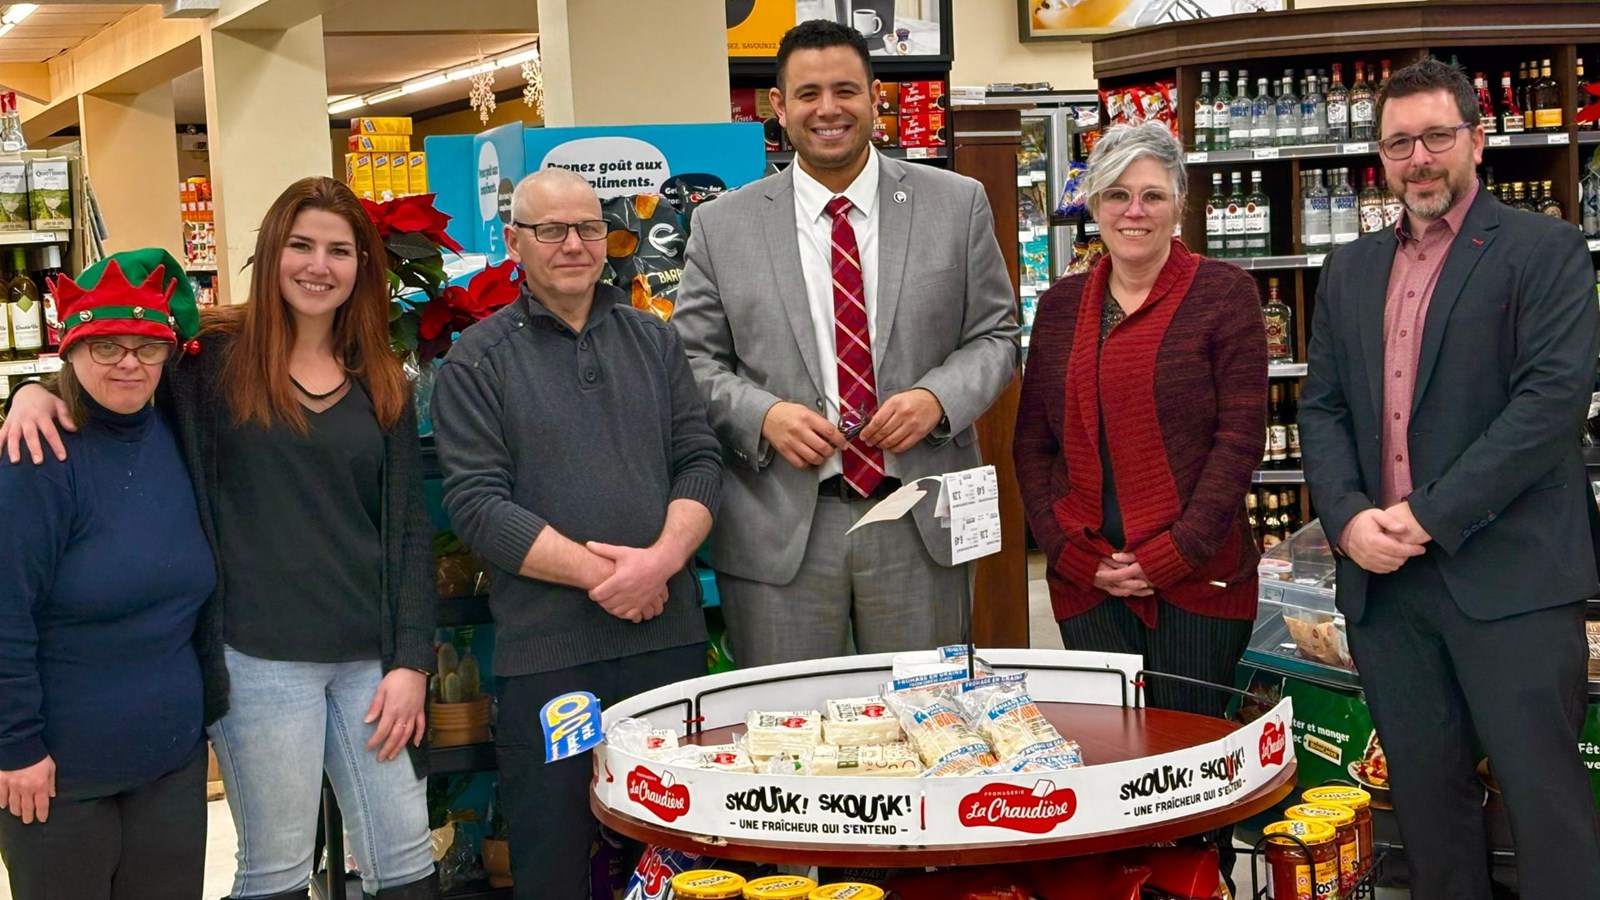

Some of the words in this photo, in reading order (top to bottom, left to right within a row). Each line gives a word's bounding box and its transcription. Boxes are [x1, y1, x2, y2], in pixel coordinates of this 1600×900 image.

[599, 160, 632, 174] goût
[635, 161, 662, 170] aux
[588, 177, 654, 188] pliments.
[1293, 718, 1305, 729] ter
[1307, 724, 1316, 733] et
[1317, 727, 1350, 743] manger
[1577, 742, 1600, 754] Fêt
[639, 780, 684, 809] Chaudière
[984, 789, 1025, 797] FROMAGERIE
[966, 801, 986, 819] La
[987, 798, 1068, 822] Chaudière
[1134, 804, 1152, 817] UNE
[1155, 793, 1202, 813] FRAÎCHEUR
[1203, 789, 1216, 801] QUI
[739, 819, 759, 830] UNE
[762, 819, 819, 833] FRAÎCHEUR
[822, 824, 839, 834] QUI
[843, 824, 897, 835] S'ENTEND
